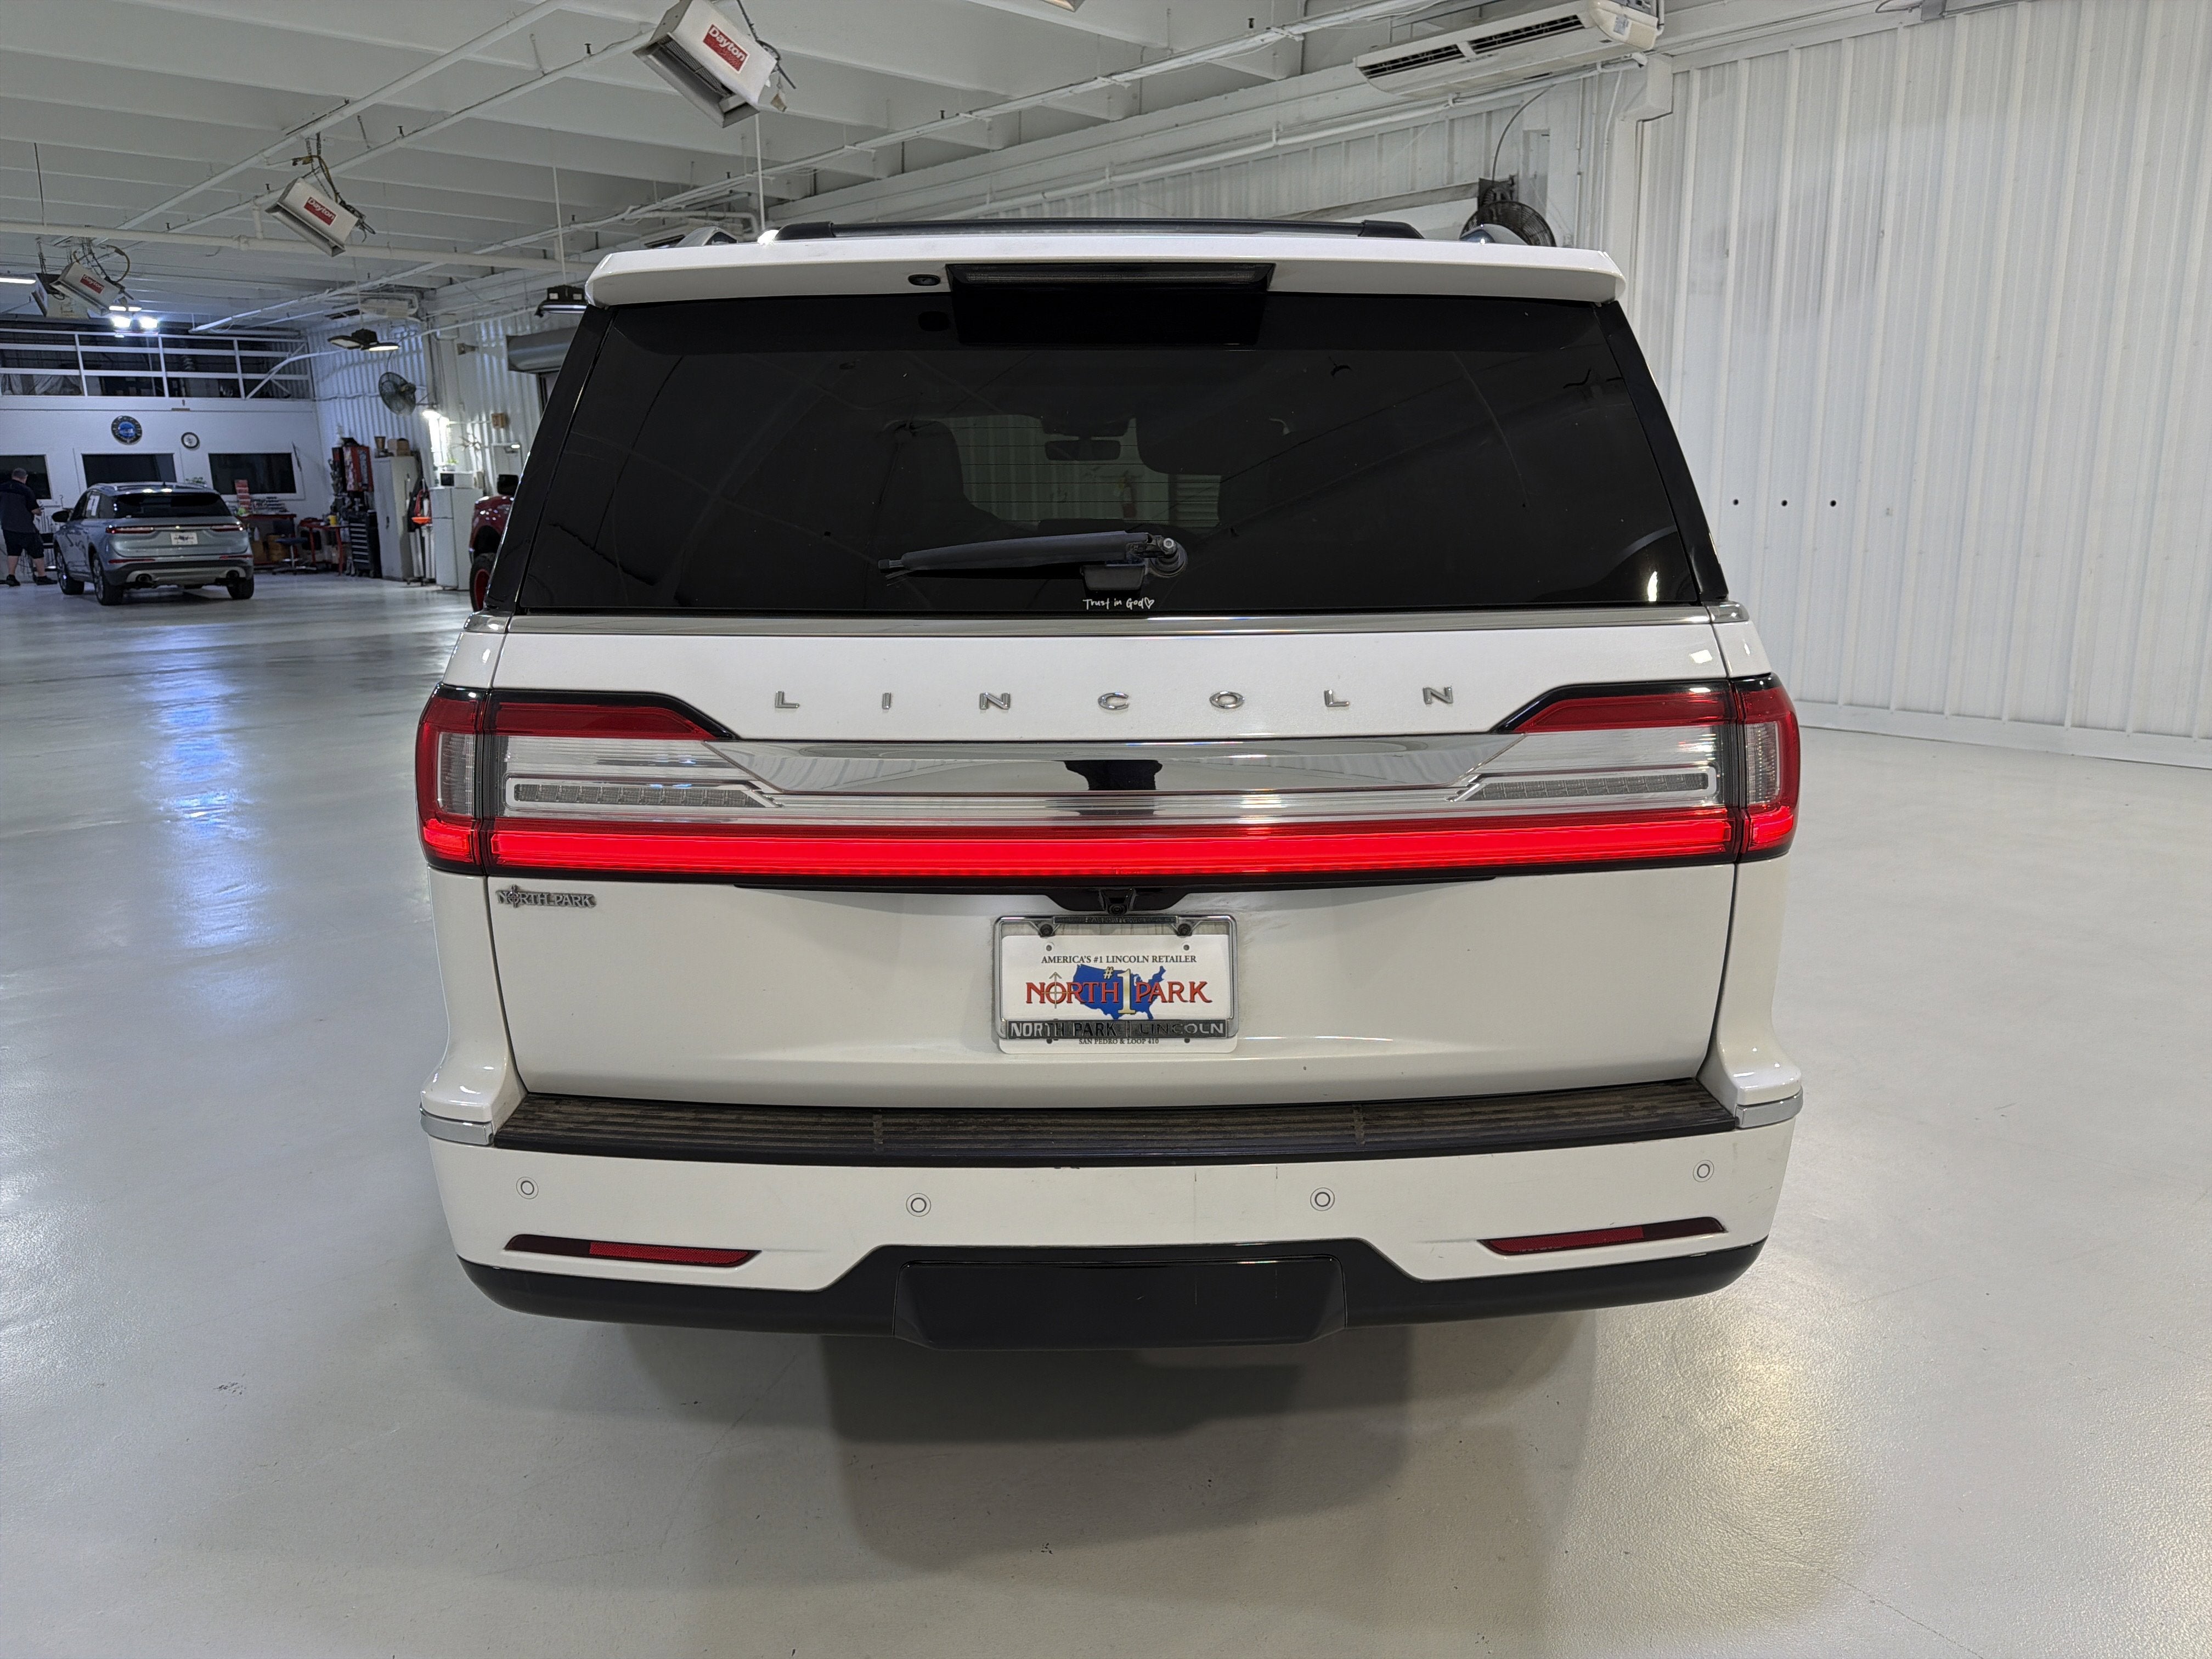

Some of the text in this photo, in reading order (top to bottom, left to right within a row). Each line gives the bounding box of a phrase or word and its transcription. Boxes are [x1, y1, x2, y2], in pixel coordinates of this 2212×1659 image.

[709, 27, 746, 62] Dayton
[308, 198, 335, 220] Dayton
[83, 275, 104, 291] Dayton
[1082, 597, 1144, 611] Trust in God
[775, 686, 1453, 711] LINCOLN
[497, 890, 594, 908] NORTH PARK
[1041, 955, 1091, 964] AMERICA'S
[1106, 955, 1149, 963] LINCOLN
[1025, 981, 1213, 1005] NORTH PARK
[1011, 1022, 1224, 1037] NORTH PARK LINCOLN
